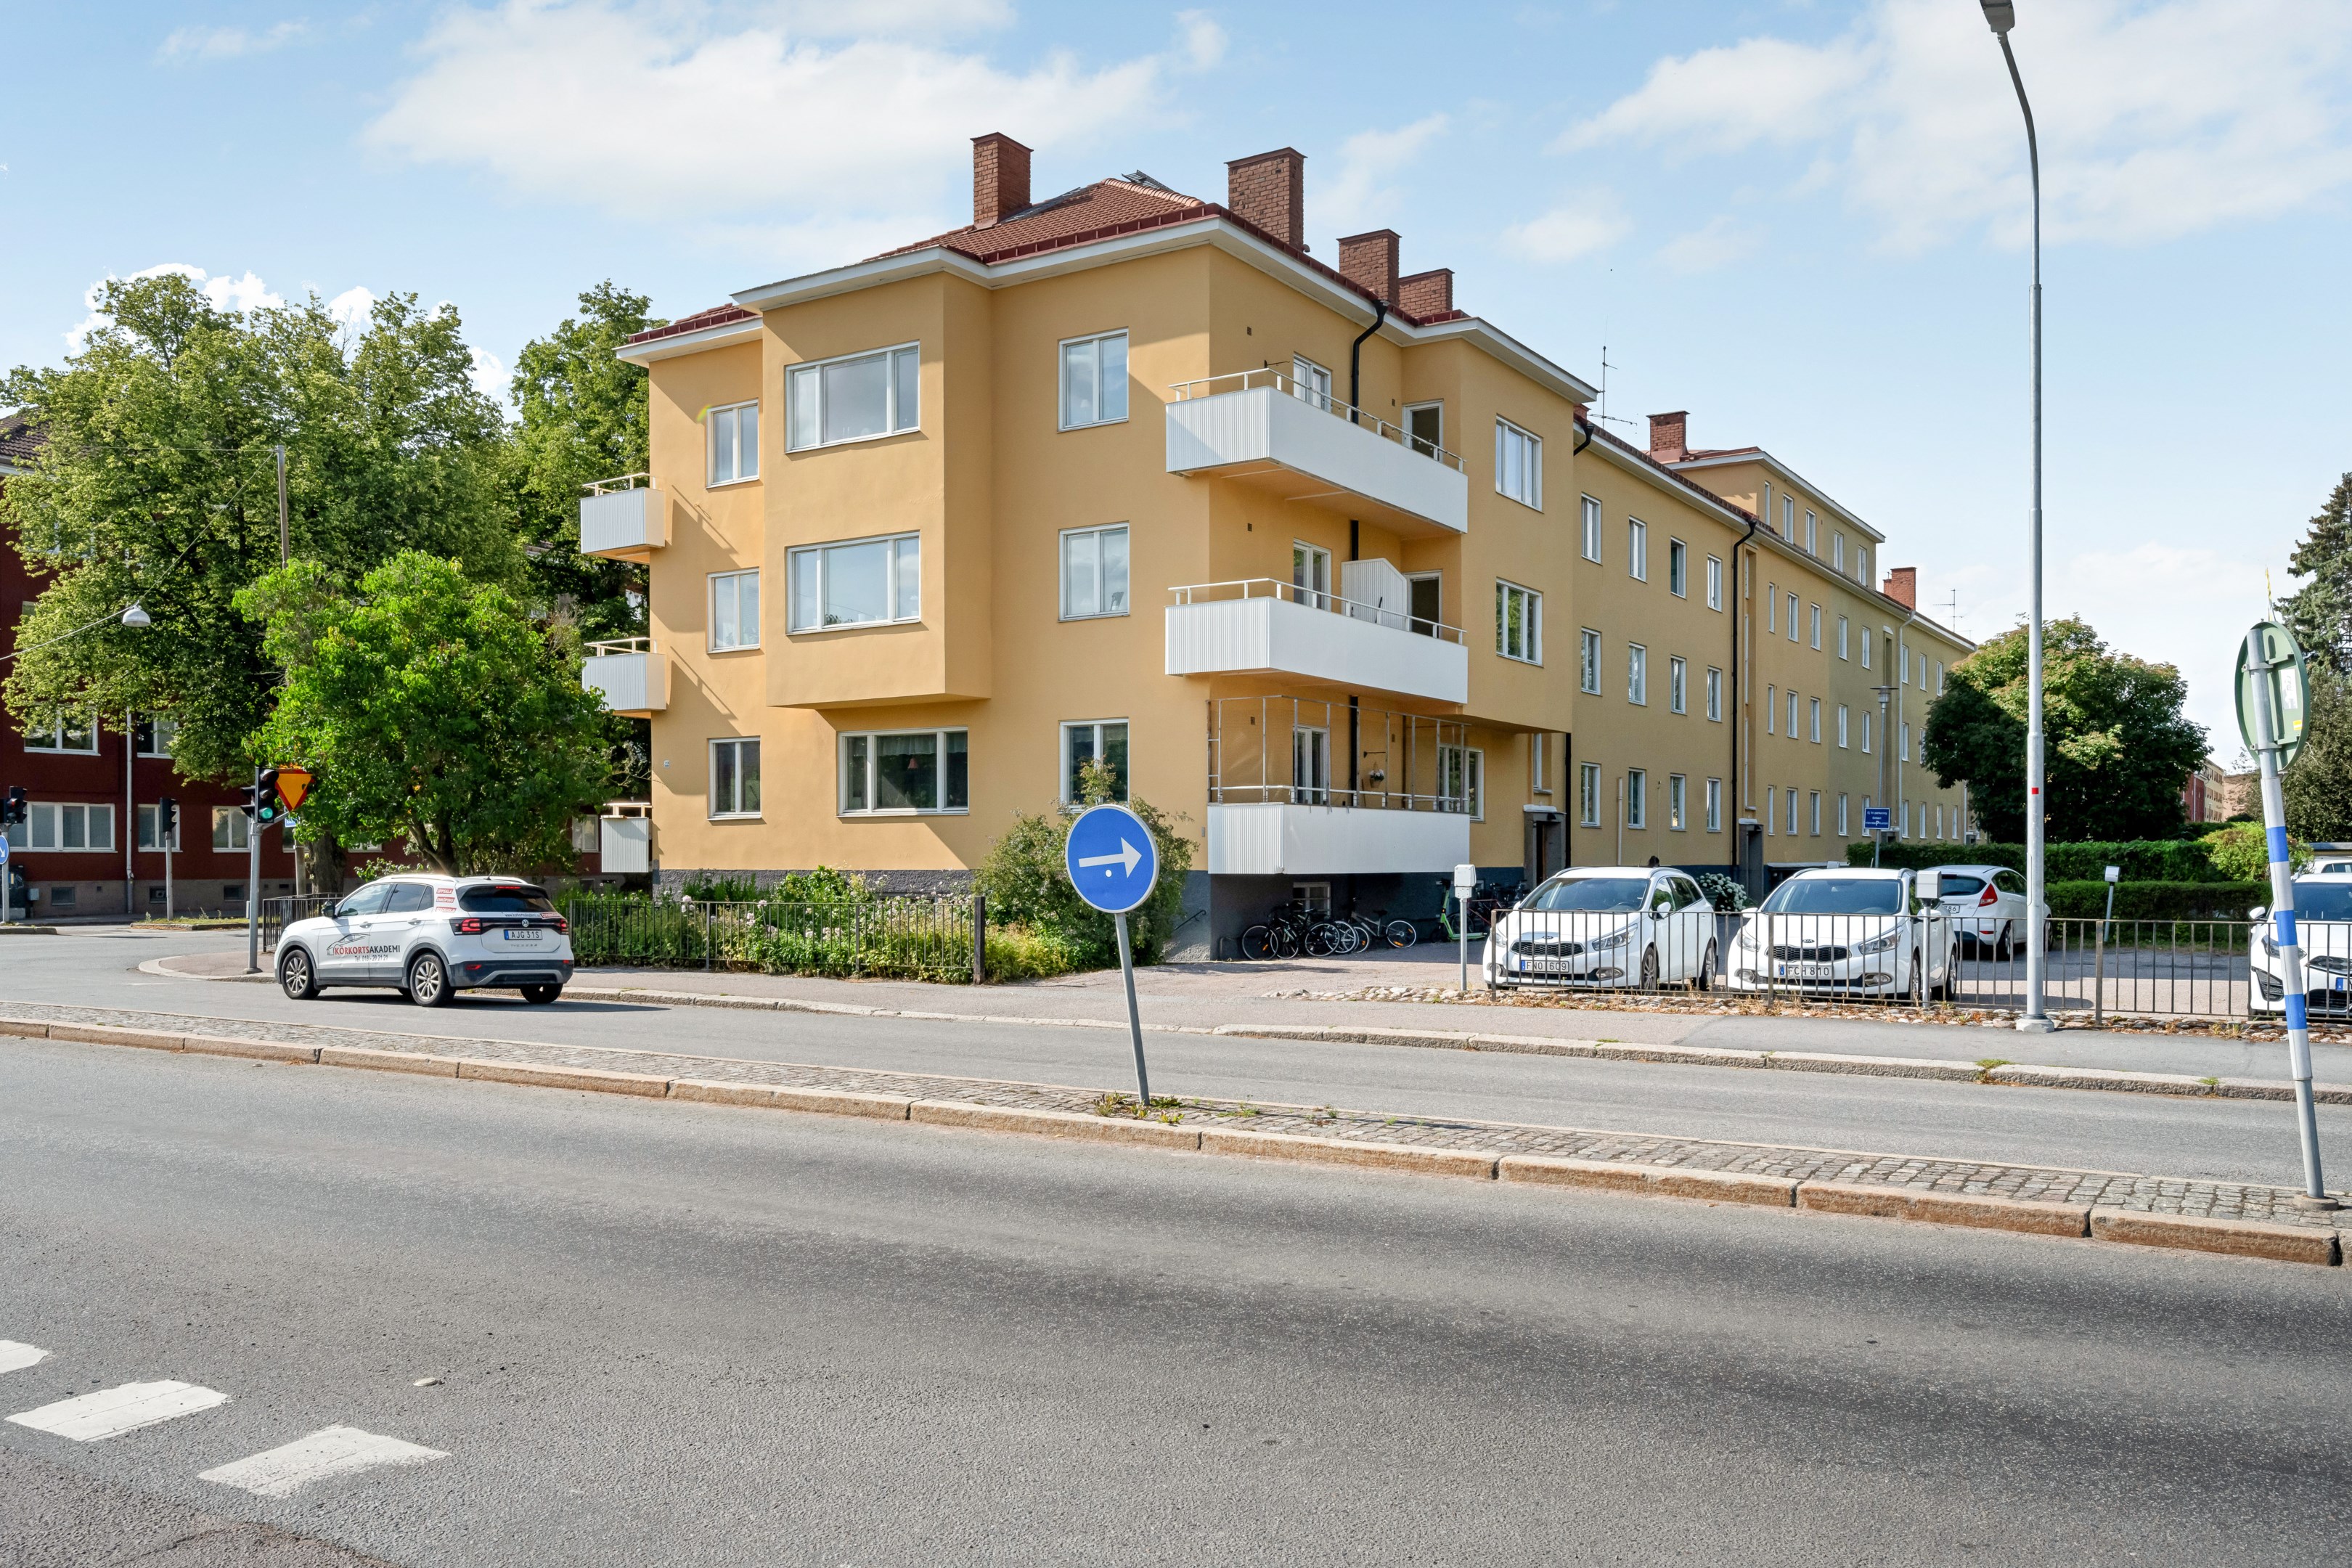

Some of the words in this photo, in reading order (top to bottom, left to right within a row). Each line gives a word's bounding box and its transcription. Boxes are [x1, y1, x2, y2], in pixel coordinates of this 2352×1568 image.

[335, 945, 400, 955] KÖRKORTSAKADEMI
[1549, 962, 1567, 971] 609
[1788, 966, 1806, 976] FCH
[1810, 967, 1829, 976] 810
